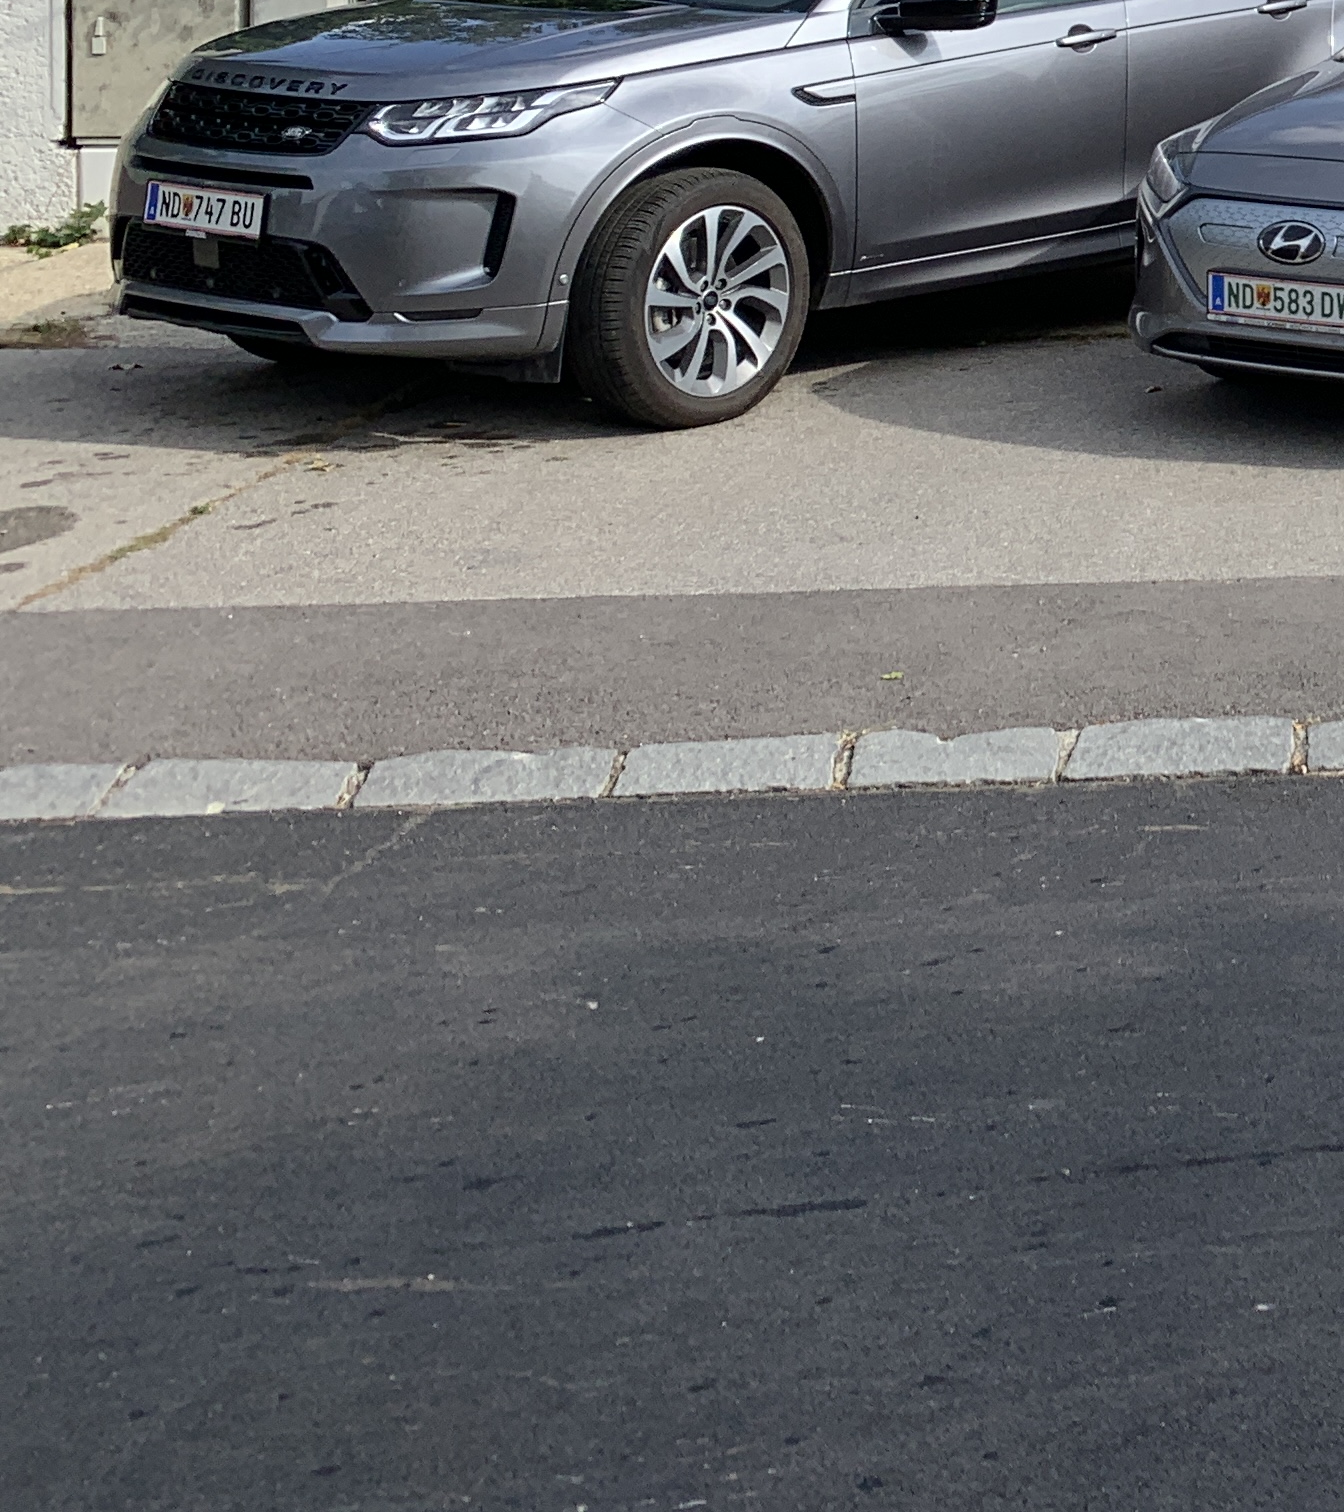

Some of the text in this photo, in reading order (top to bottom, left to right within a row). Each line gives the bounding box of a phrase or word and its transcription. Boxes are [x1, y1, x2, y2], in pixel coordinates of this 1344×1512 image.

[191, 68, 348, 95] DISCOVERY
[160, 190, 255, 229] ND 747 BU
[1227, 281, 1254, 309] ND
[1273, 286, 1315, 317] 583
